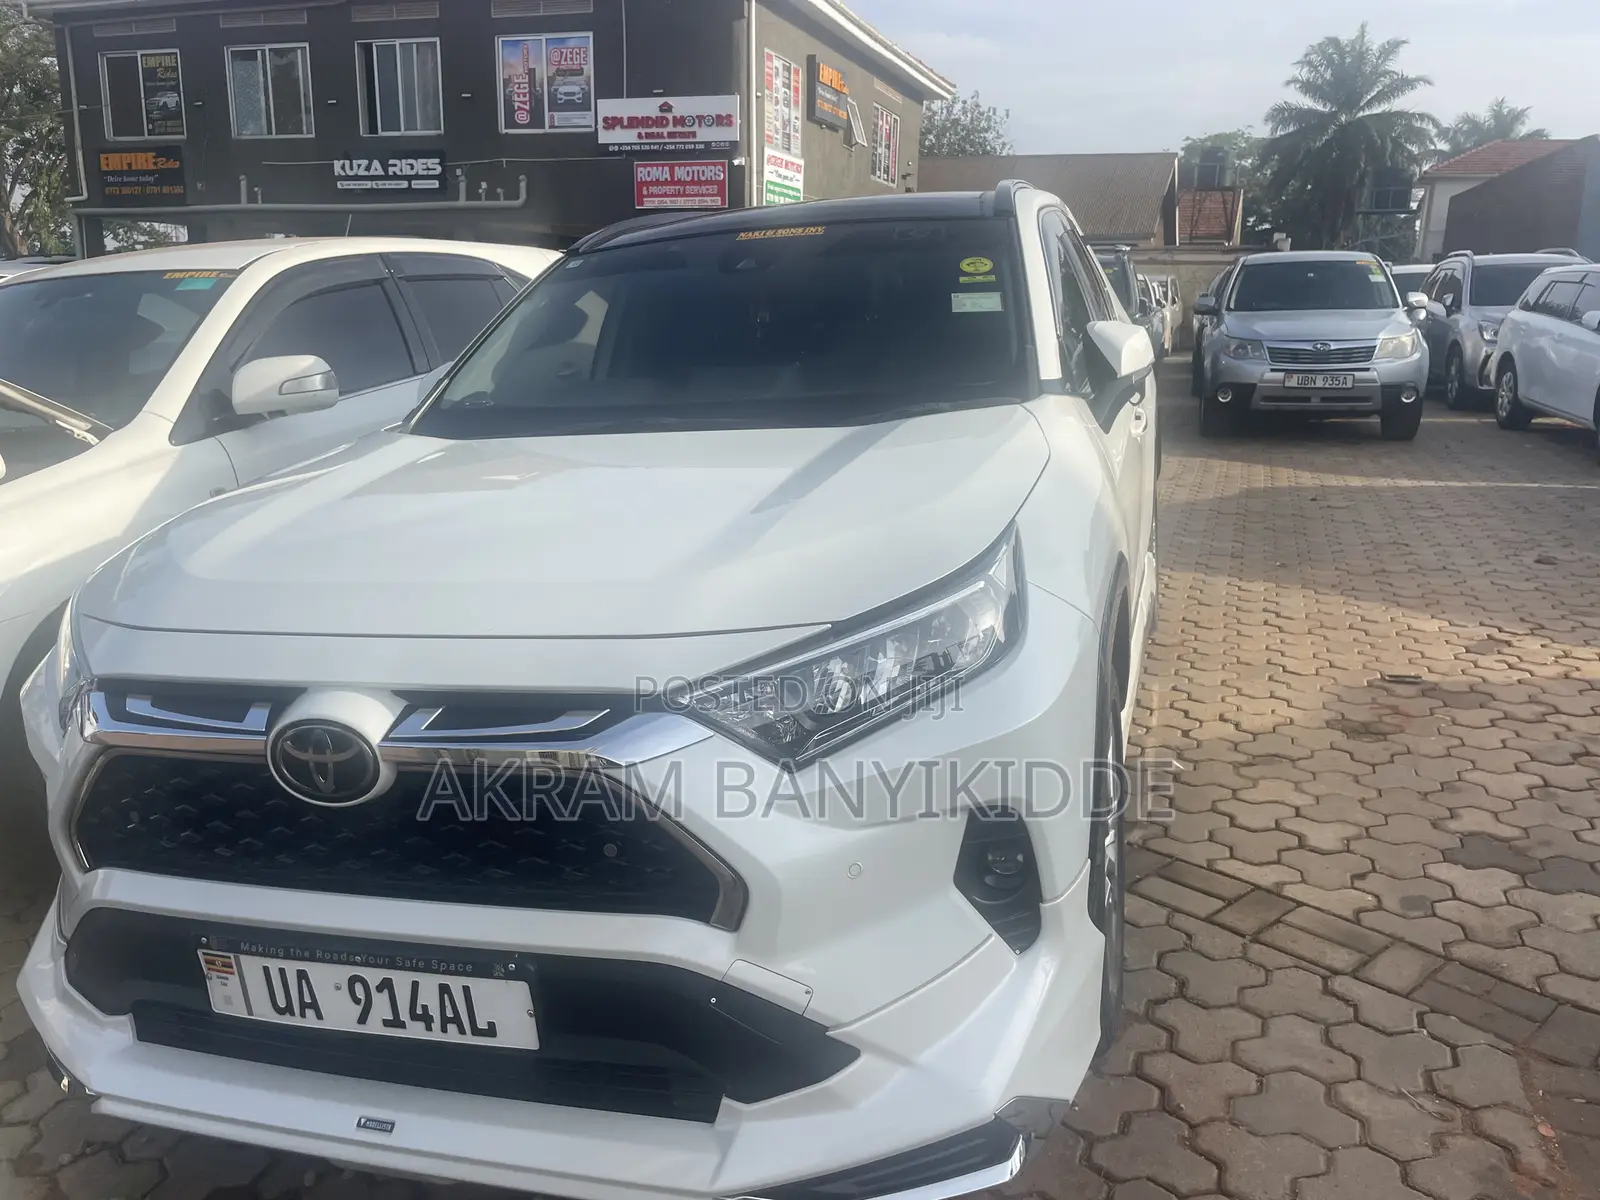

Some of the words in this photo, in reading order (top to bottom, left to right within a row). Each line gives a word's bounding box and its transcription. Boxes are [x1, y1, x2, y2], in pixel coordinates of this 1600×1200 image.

[142, 55, 177, 68] EMPIRE
[550, 47, 588, 65] @ZEGE
[514, 74, 530, 124] @ZEGE
[602, 115, 670, 131] SPLENDID
[672, 114, 734, 128] MOTORS
[100, 153, 157, 170] EMPIRE
[333, 159, 385, 176] KUZA
[388, 158, 442, 175] RIDES
[637, 166, 671, 181] ROMA
[674, 165, 724, 181] MOTORS
[642, 187, 648, 195] &
[648, 186, 684, 195] PROPERTY
[685, 185, 718, 194] SERVICES
[775, 228, 803, 236] SONS
[163, 271, 217, 279] EMPIRE
[1296, 375, 1317, 387] UBN
[1322, 375, 1348, 387] 935A
[240, 941, 284, 956] Making
[290, 948, 310, 958] the
[316, 949, 356, 962] Roads
[360, 953, 390, 965] Your
[395, 956, 425, 968] Safe
[431, 959, 473, 973] Space
[262, 965, 325, 1021] UA
[347, 973, 498, 1039] 914AL
